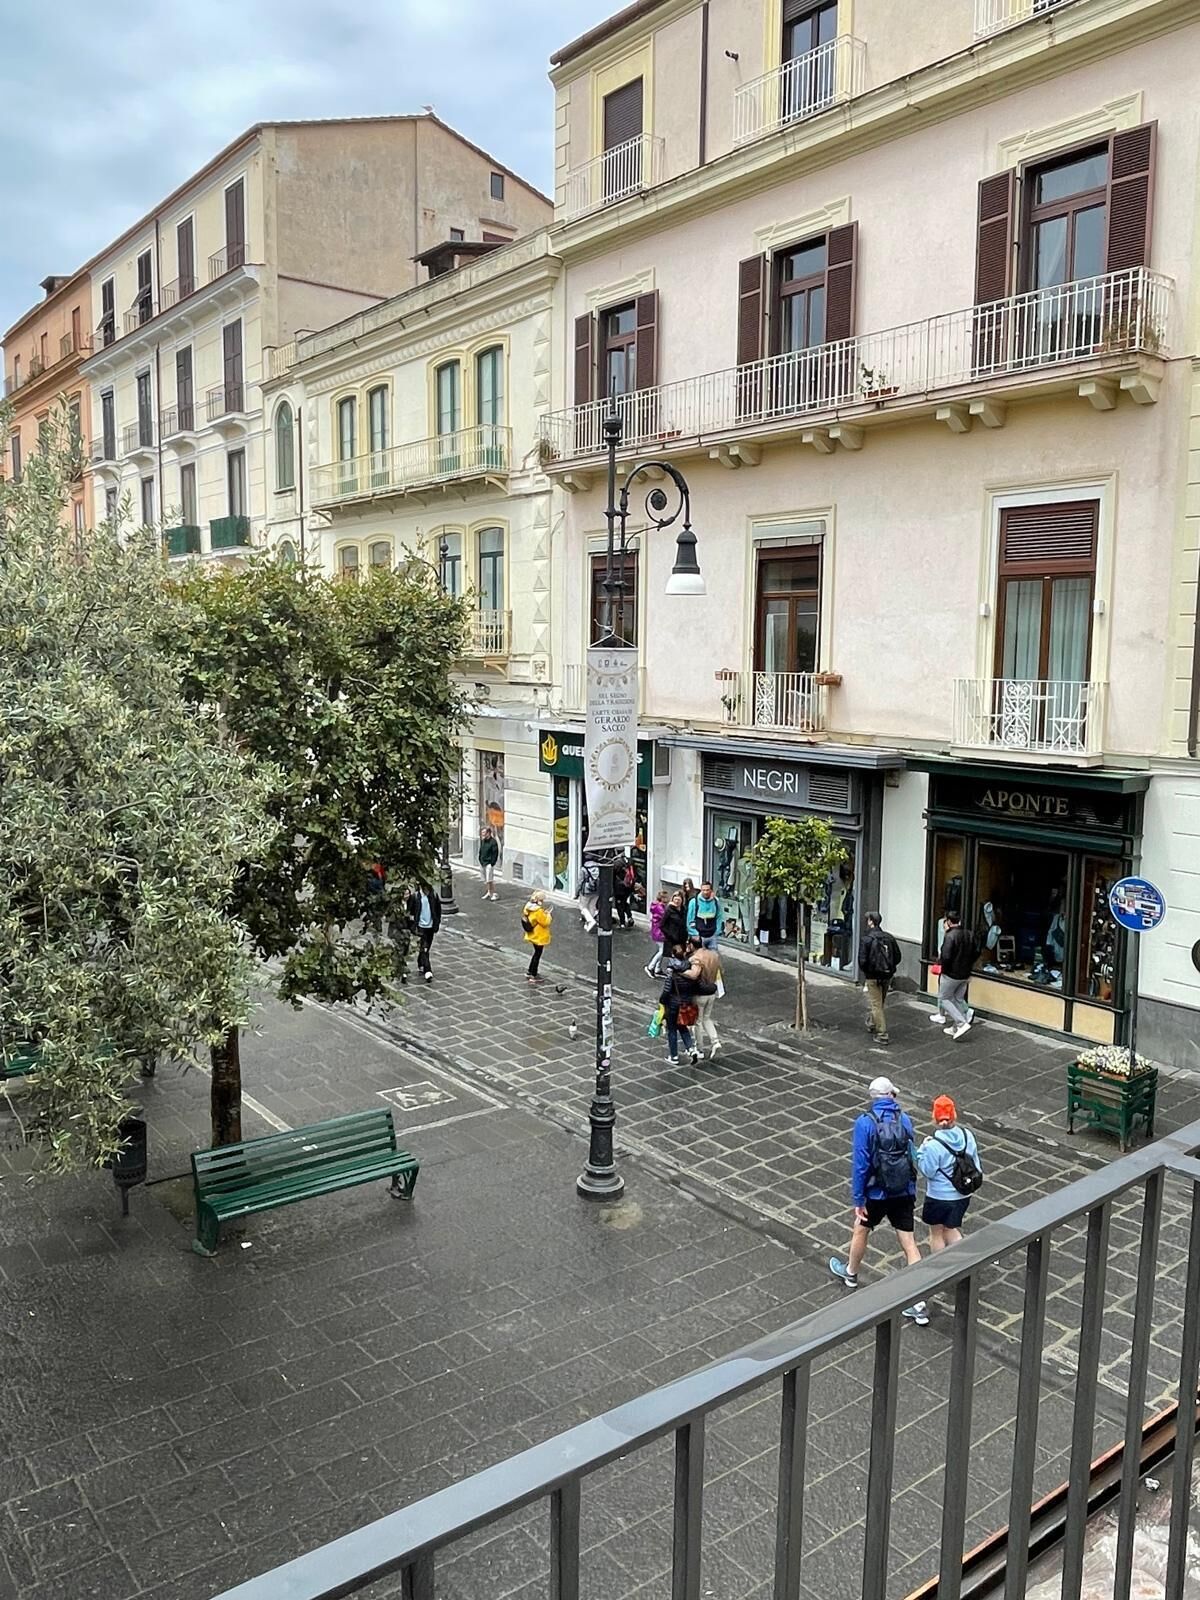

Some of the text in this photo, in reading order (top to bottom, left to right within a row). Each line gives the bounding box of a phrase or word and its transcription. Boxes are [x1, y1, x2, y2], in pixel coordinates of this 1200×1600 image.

[594, 715, 631, 724] GERARDO
[601, 723, 626, 733] SACCO
[743, 767, 799, 794] NEGRI
[979, 789, 1070, 816] APONTE
